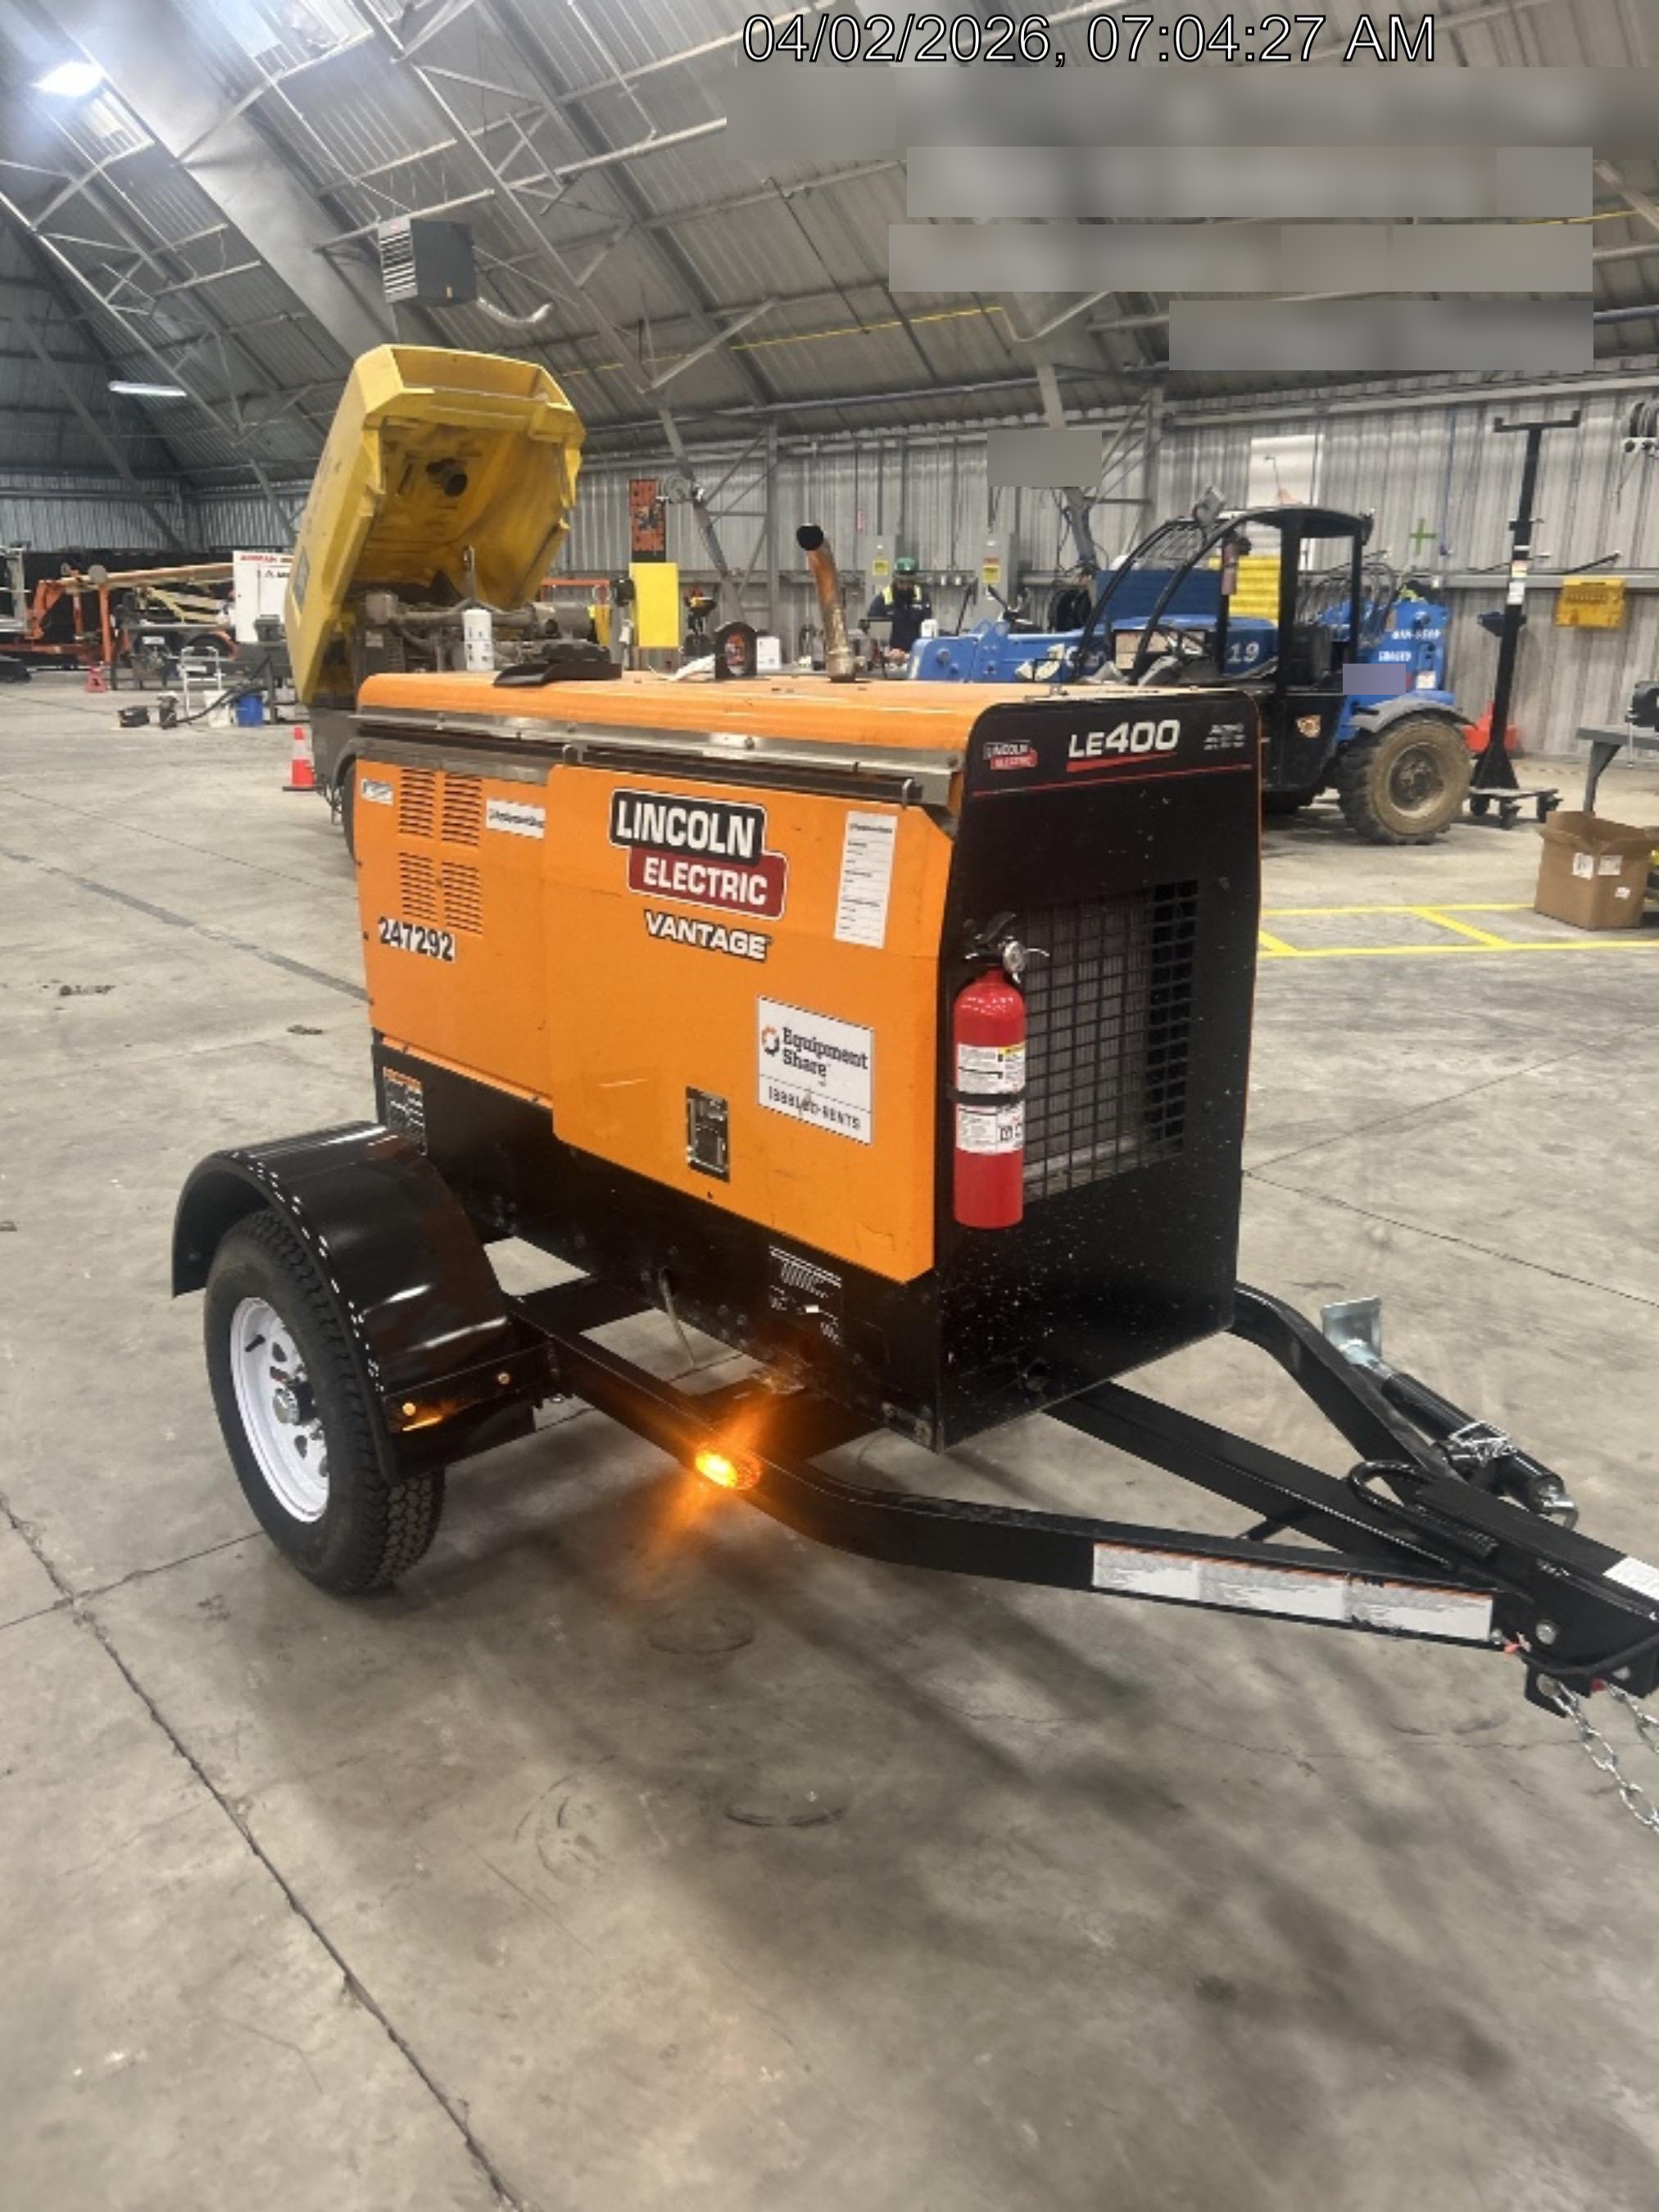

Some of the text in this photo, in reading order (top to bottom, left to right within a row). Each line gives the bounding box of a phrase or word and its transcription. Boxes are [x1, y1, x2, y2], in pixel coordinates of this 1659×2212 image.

[1228, 641, 1259, 663] 19
[1067, 718, 1180, 759] LE400
[615, 800, 755, 859] LINCOLN
[642, 855, 768, 906] ELECTRIC
[378, 916, 453, 962] 247292
[644, 909, 767, 962] VANTAGE
[782, 1026, 868, 1070] Equipment
[782, 1047, 827, 1077] Share
